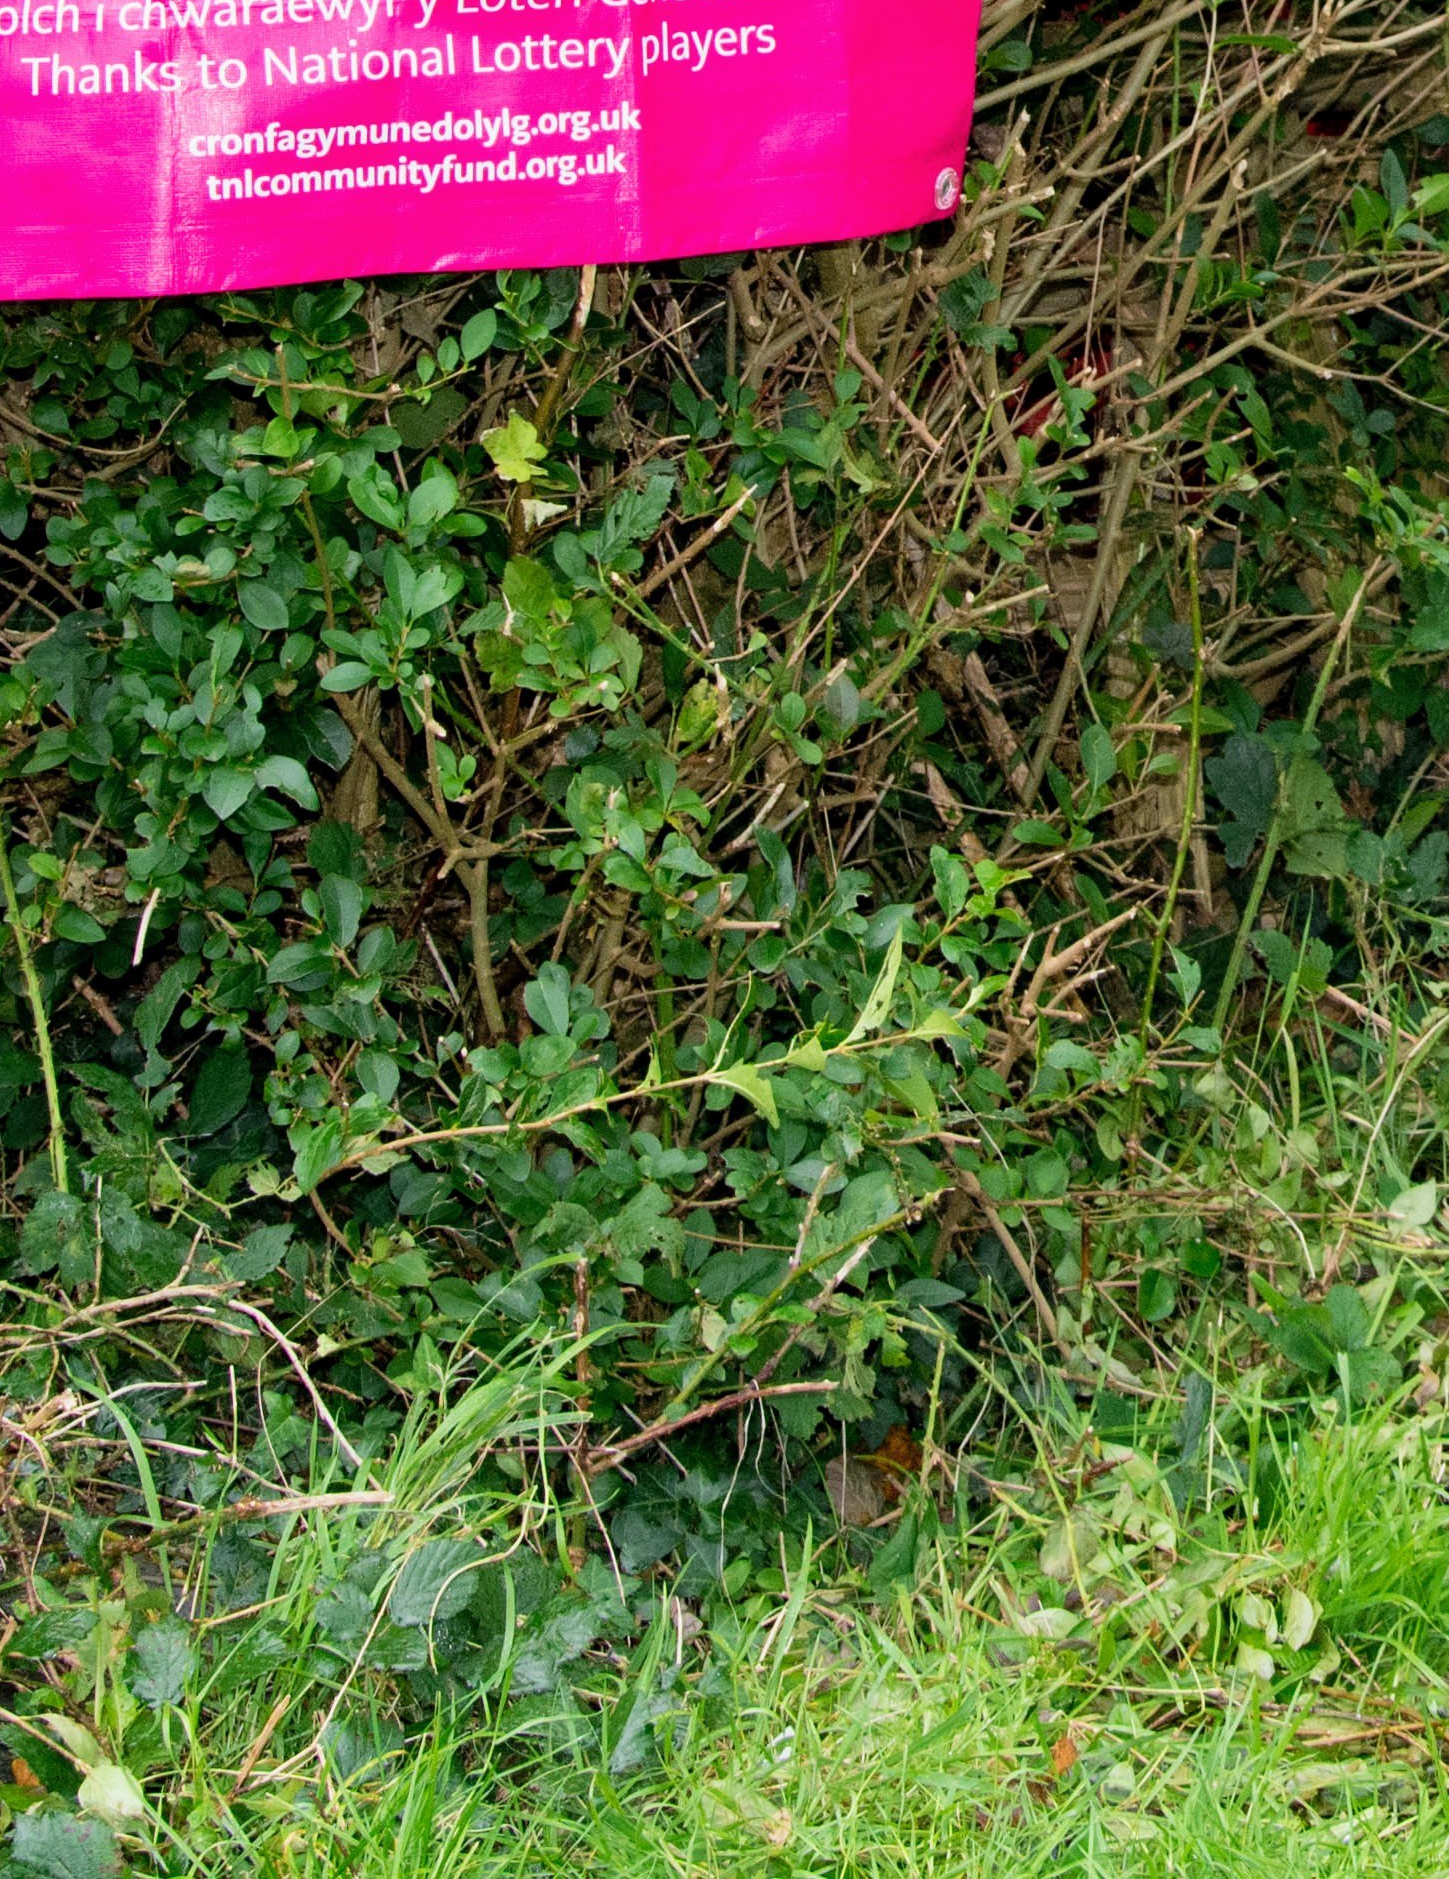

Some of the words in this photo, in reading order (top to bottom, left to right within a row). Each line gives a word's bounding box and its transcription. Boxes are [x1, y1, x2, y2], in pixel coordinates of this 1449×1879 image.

[20, 51, 182, 96] Thanks
[199, 55, 248, 91] to
[263, 34, 456, 87] National
[471, 33, 631, 80] Lottery
[641, 20, 777, 77] players
[188, 101, 642, 159] cronfagymunedolylg.org.uk
[206, 145, 628, 200] tnlcommunityfund.org.uk
